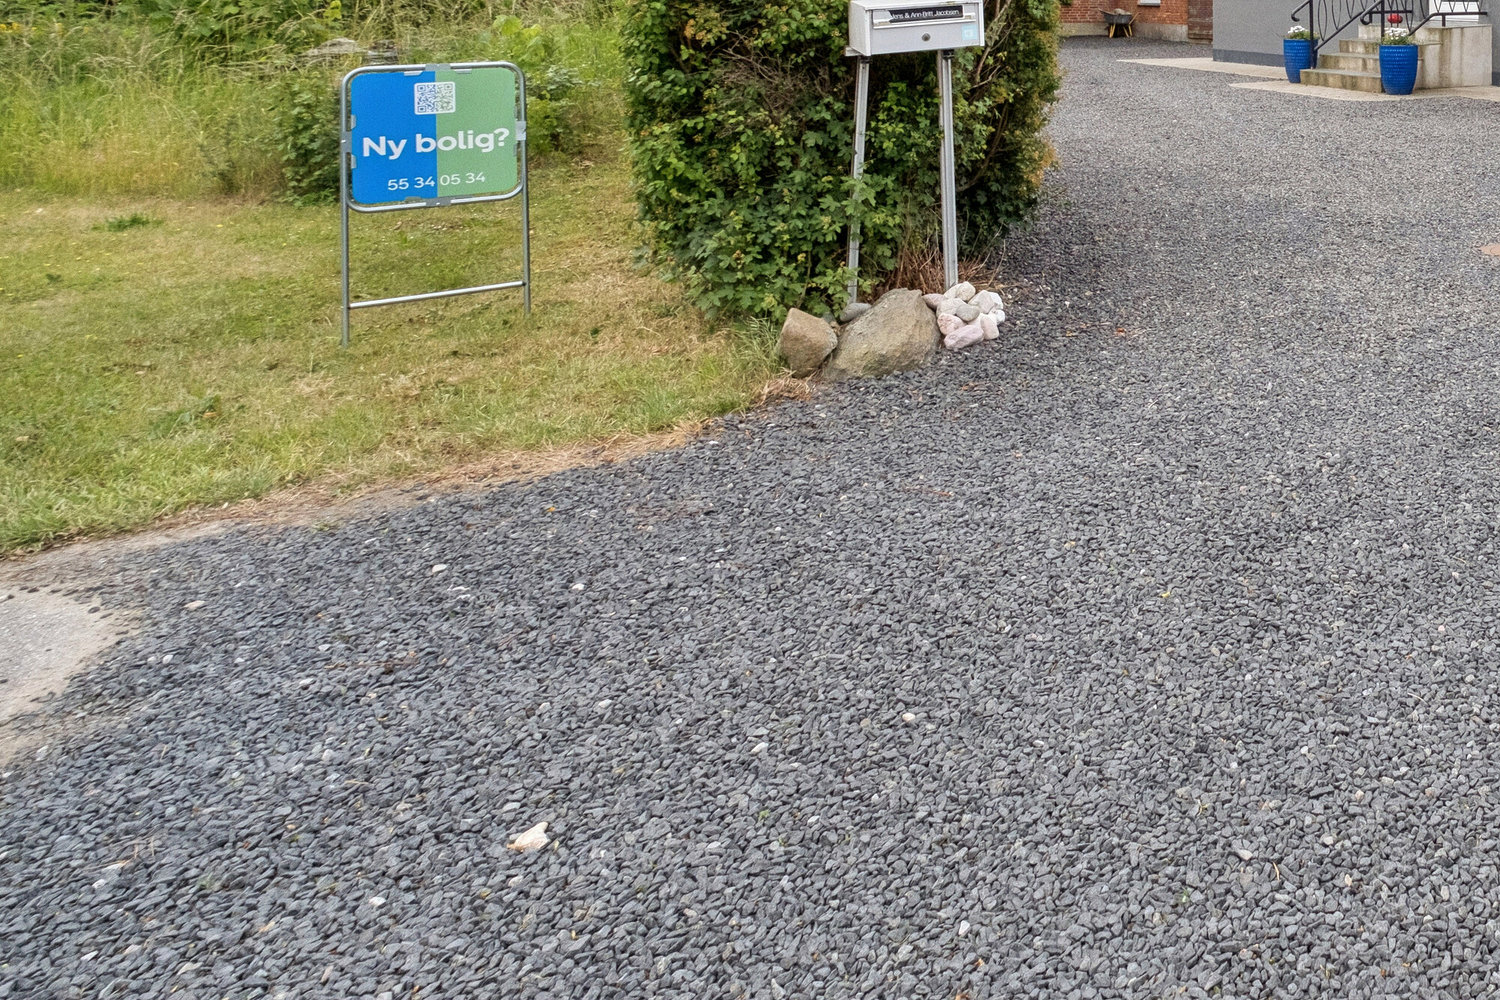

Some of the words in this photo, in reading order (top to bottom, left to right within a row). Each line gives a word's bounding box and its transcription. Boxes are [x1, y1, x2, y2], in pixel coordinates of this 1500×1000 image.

[363, 136, 407, 160] Ny
[415, 127, 510, 153] bolig?
[387, 179, 409, 191] 55
[413, 176, 436, 188] 34
[440, 174, 461, 186] 05
[465, 172, 486, 184] 34
